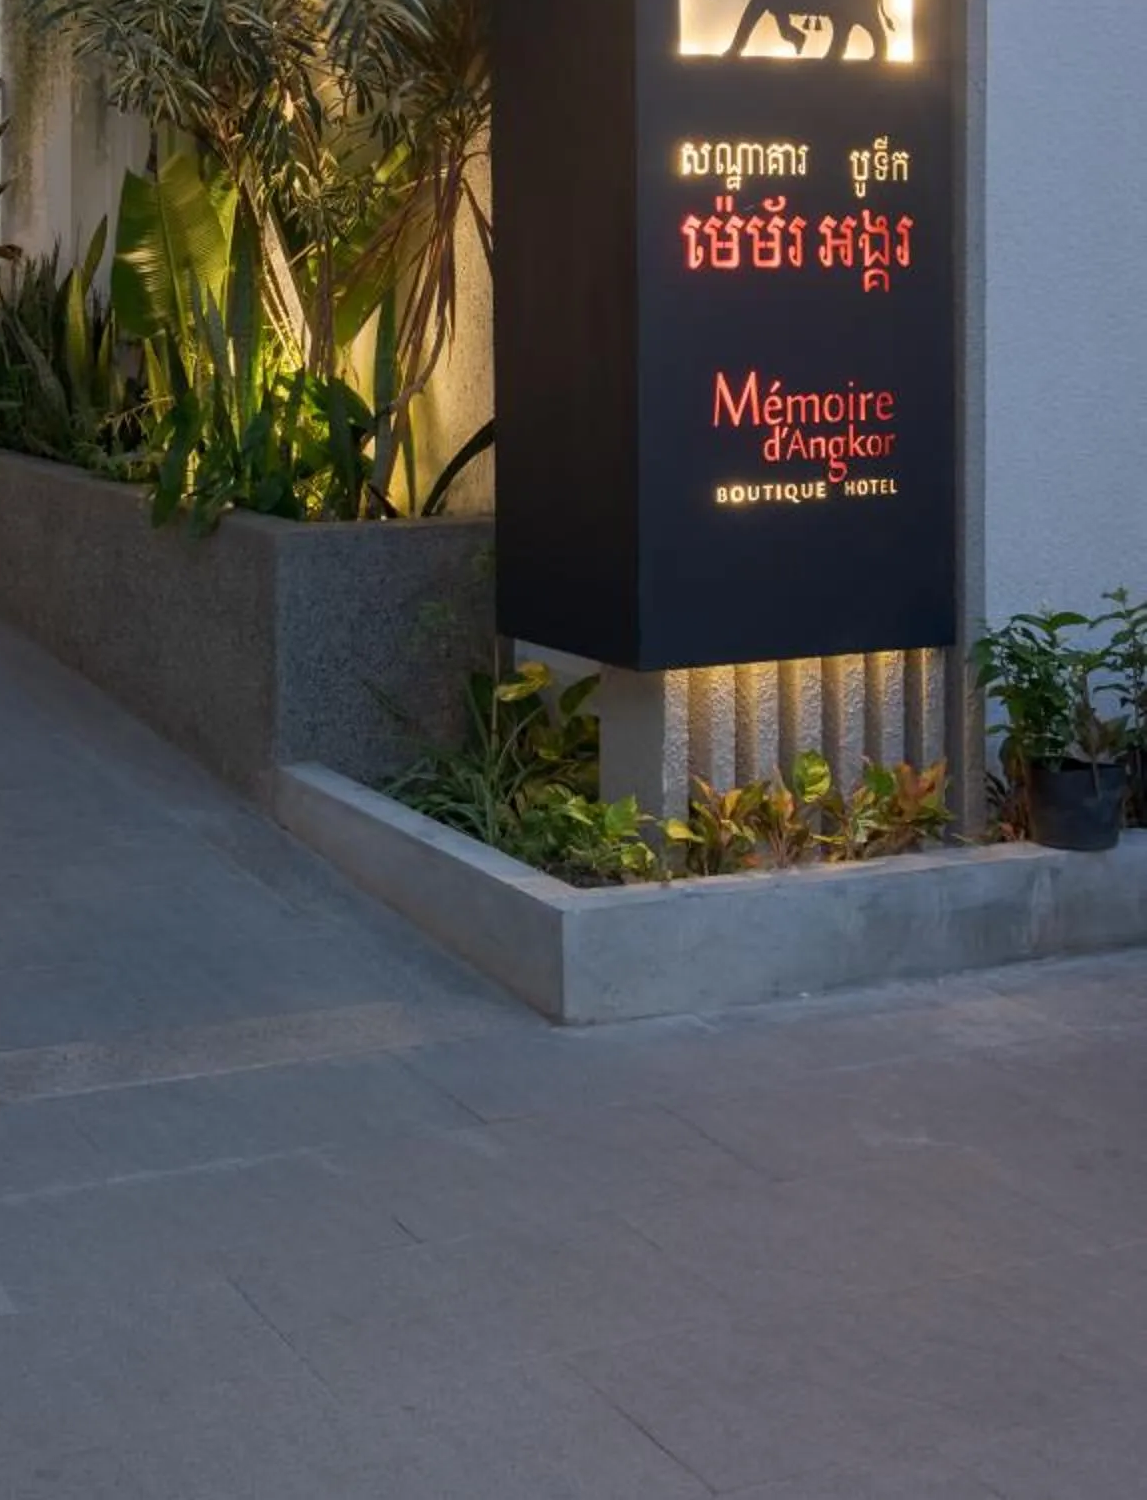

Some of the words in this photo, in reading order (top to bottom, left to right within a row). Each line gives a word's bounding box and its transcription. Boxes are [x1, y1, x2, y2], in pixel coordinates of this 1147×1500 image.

[818, 209, 914, 293] អង្គរ
[713, 371, 895, 428] Mémoire
[763, 423, 896, 484] d'Angkor
[716, 481, 827, 504] BOUTIQUE
[844, 478, 898, 497] HOTEL
